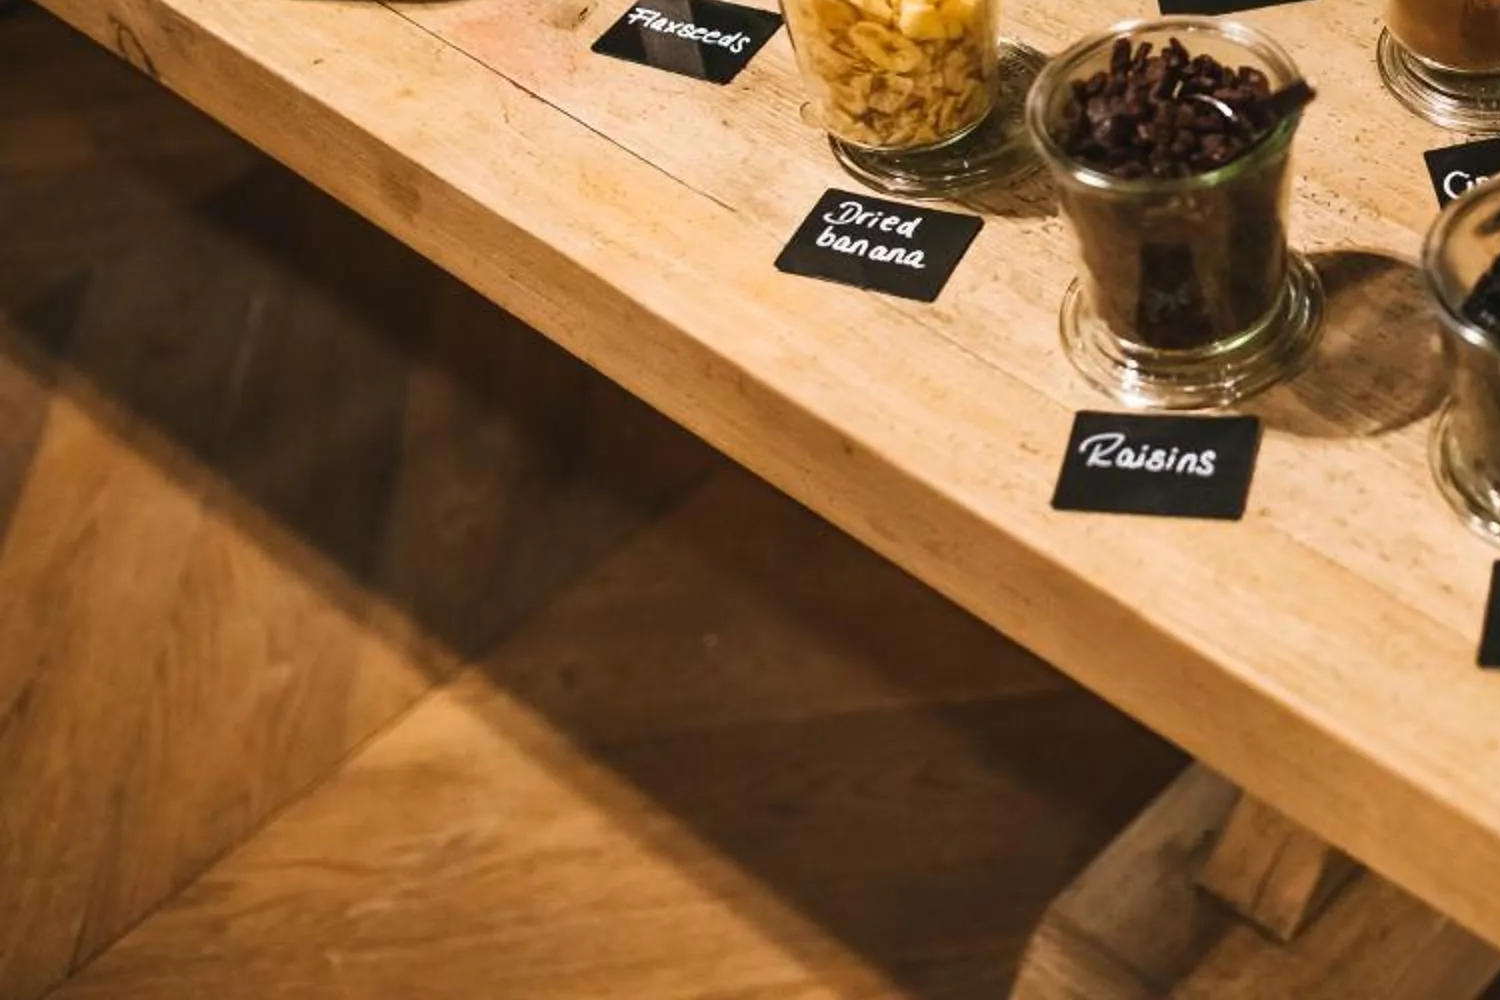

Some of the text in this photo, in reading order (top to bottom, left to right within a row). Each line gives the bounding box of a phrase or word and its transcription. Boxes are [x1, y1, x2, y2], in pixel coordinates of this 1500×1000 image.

[628, 7, 751, 54] Flaxseeds
[823, 201, 923, 239] Dried
[815, 225, 926, 269] banana
[1078, 432, 1217, 477] Raisins
